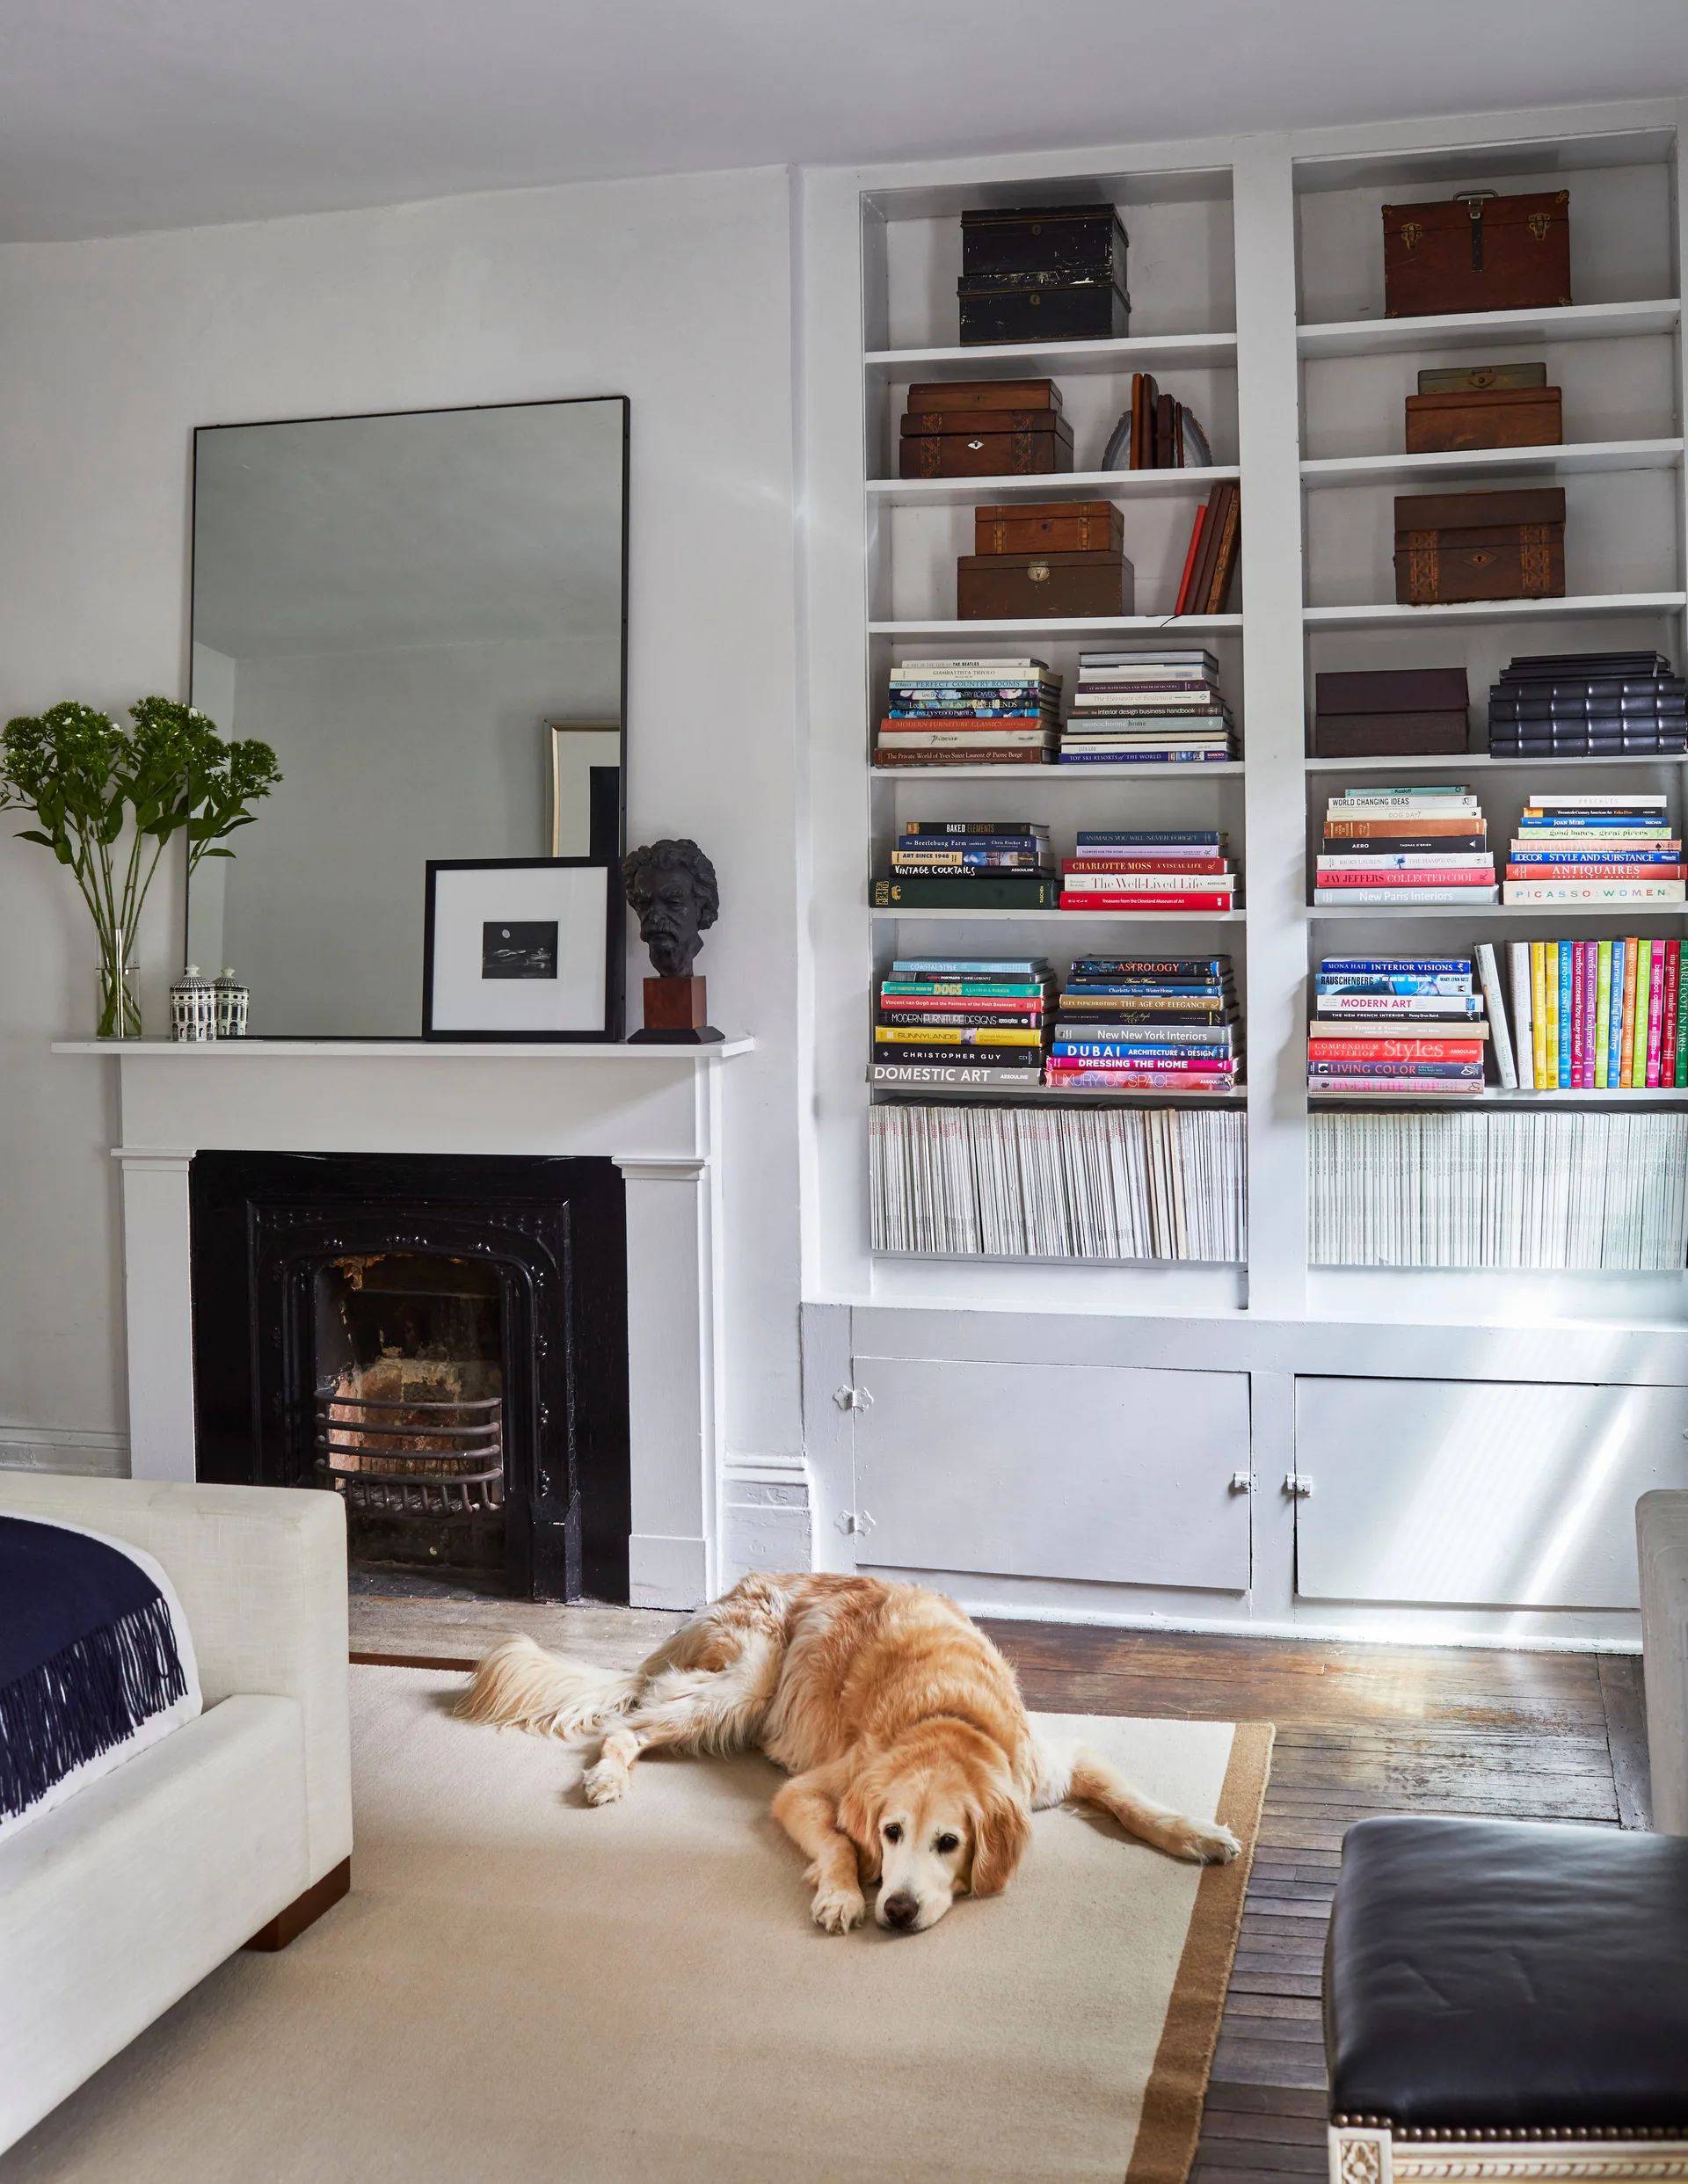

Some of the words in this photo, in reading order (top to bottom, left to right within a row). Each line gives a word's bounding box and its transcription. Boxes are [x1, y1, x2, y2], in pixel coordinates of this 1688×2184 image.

[946, 824, 965, 833] BAKED
[967, 824, 994, 833] ELEMENTS
[1549, 853, 1578, 862] STYLE
[1602, 853, 1655, 862] SUBSTANCE
[894, 865, 929, 875] VINTAGE
[932, 865, 976, 876] COCKTAILS
[1553, 865, 1640, 875] ANTIQUAIRES
[1091, 877, 1114, 889] The
[1116, 877, 1176, 889] Well-Lived
[1181, 877, 1203, 889] Life
[1342, 874, 1384, 883] JEFFERS
[1386, 873, 1445, 883] COLLECTED
[1447, 872, 1474, 881] COOL
[1359, 892, 1383, 901] New
[1385, 892, 1408, 900] Paris
[1411, 892, 1453, 900] Interiors
[1117, 963, 1180, 972] ASTROLOGY
[1321, 976, 1373, 986] RAUSCHENBERG
[1668, 966, 1677, 987] garten
[933, 984, 963, 995] DOGS
[1341, 999, 1388, 1008] MODERN
[891, 1014, 923, 1023] MODERN
[923, 1014, 964, 1024] FURNITURE
[964, 1016, 997, 1025] DESIGNS
[1679, 1012, 1688, 1023] IN
[1573, 1019, 1582, 1034] easy
[1097, 1030, 1119, 1039] New
[1121, 1030, 1142, 1039] New
[1144, 1030, 1166, 1040] York
[1167, 1030, 1207, 1040] Interiors
[1678, 1025, 1687, 1052] PARIS
[1067, 1045, 1120, 1057] DUBAI
[1384, 1039, 1444, 1061] Styles
[1134, 1059, 1153, 1068] THE
[1329, 1064, 1371, 1074] LIVING
[1374, 1065, 1415, 1074] COLOR
[874, 1067, 956, 1081] DOMESTIC
[960, 1069, 991, 1081] ART
[1051, 1074, 1102, 1087] LUXURY
[1105, 1074, 1124, 1087] OF
[1128, 1074, 1175, 1088] SPACE
